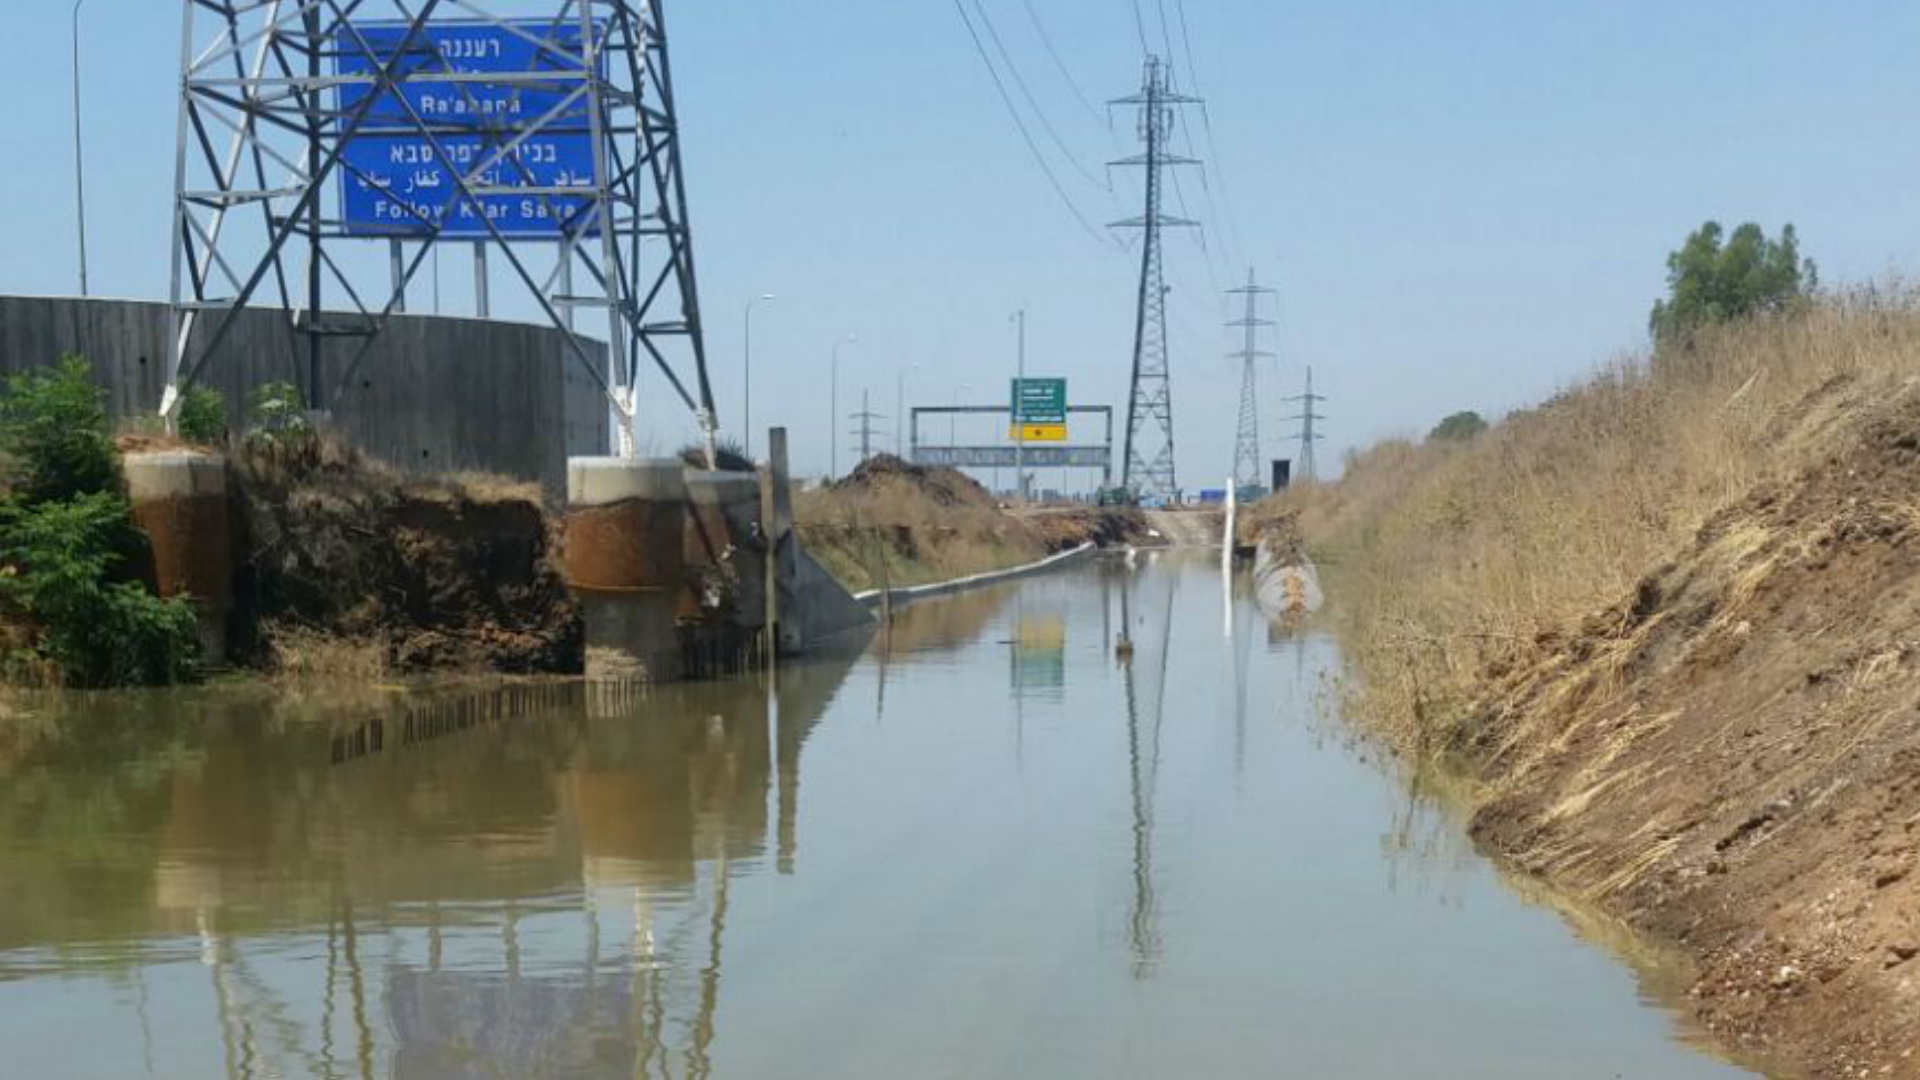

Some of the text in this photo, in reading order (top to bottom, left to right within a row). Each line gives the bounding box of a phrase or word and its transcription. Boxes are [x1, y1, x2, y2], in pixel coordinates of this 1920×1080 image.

[440, 38, 500, 58] רעננה
[420, 95, 521, 114] Ra'aana
[390, 144, 434, 164] סבא
[404, 169, 441, 194] كفار
